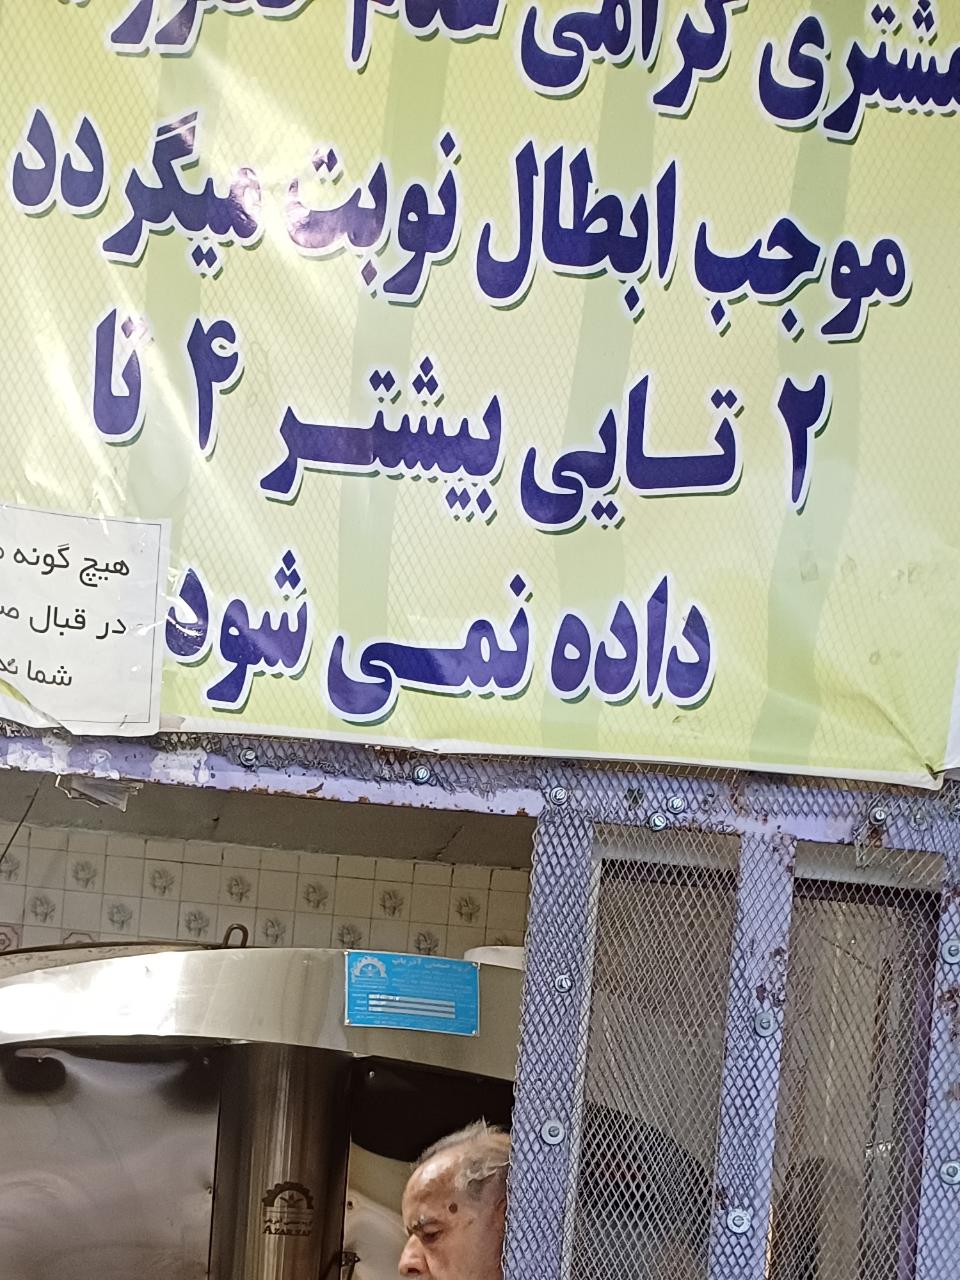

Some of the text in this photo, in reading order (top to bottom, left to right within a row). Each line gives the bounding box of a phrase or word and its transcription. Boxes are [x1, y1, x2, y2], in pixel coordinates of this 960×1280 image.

[758, 0, 960, 133] شتری
[287, 131, 458, 296] نوبت
[476, 140, 677, 311] ابطال
[693, 217, 907, 336] موجب
[93, 308, 827, 525] ۲ تایی بیشتر ۴ تا
[13, 543, 71, 575] گونه
[78, 555, 130, 587] هیچ
[27, 659, 73, 687] شما
[29, 604, 86, 636] قبال
[96, 617, 128, 639] در
[165, 549, 712, 716] داده نمی شود
